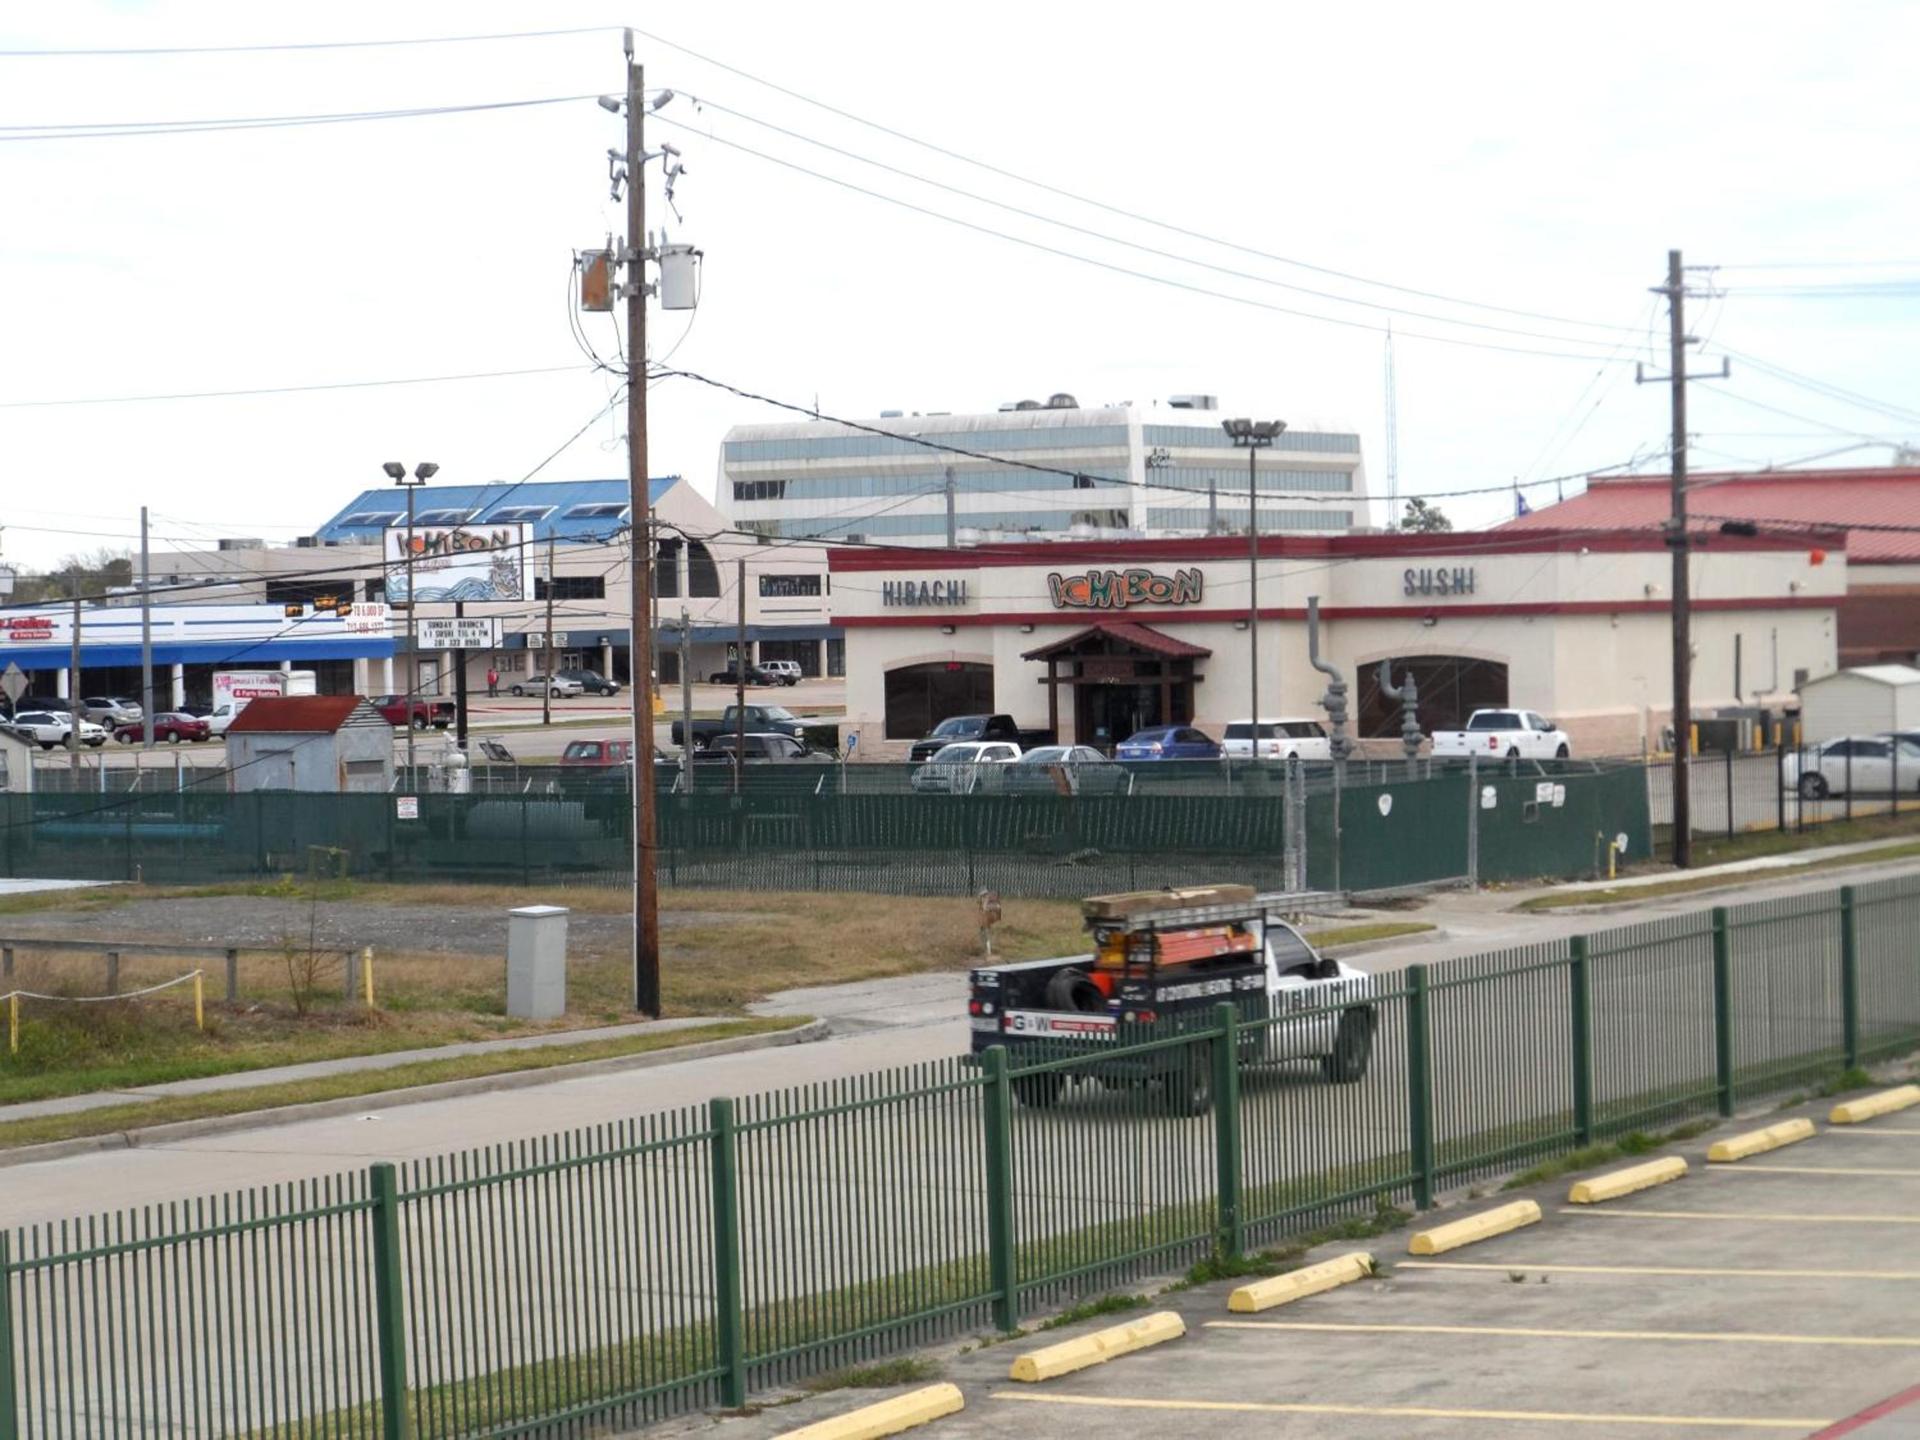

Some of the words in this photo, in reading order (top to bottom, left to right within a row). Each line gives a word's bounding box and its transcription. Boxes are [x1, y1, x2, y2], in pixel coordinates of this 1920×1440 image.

[882, 580, 967, 607] HIBACHI
[1047, 567, 1204, 609] ICHIBON
[1403, 567, 1475, 596] SUSHI
[427, 621, 452, 629] SUNDAY
[458, 621, 485, 629] BRUNCH
